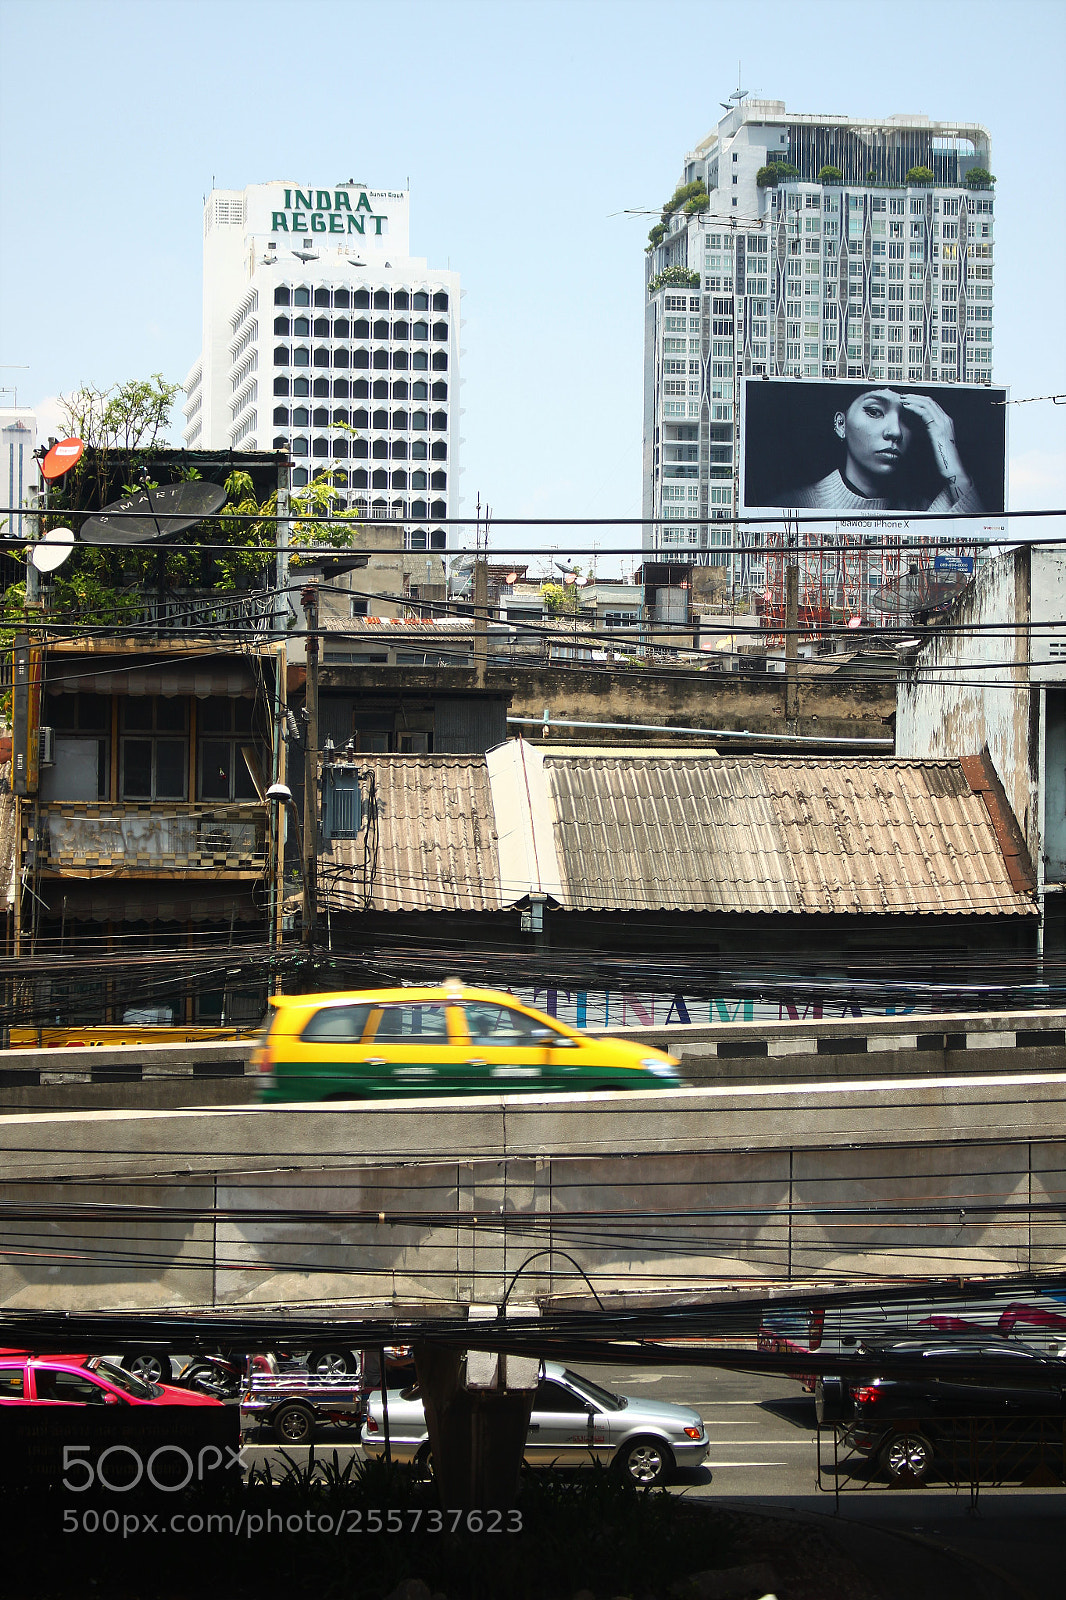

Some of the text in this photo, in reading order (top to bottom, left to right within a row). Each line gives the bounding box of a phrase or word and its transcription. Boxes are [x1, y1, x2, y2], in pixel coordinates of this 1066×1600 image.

[284, 189, 373, 213] INDRA
[271, 211, 388, 235] REGENT
[874, 519, 903, 529] iPhone
[904, 520, 910, 529] X
